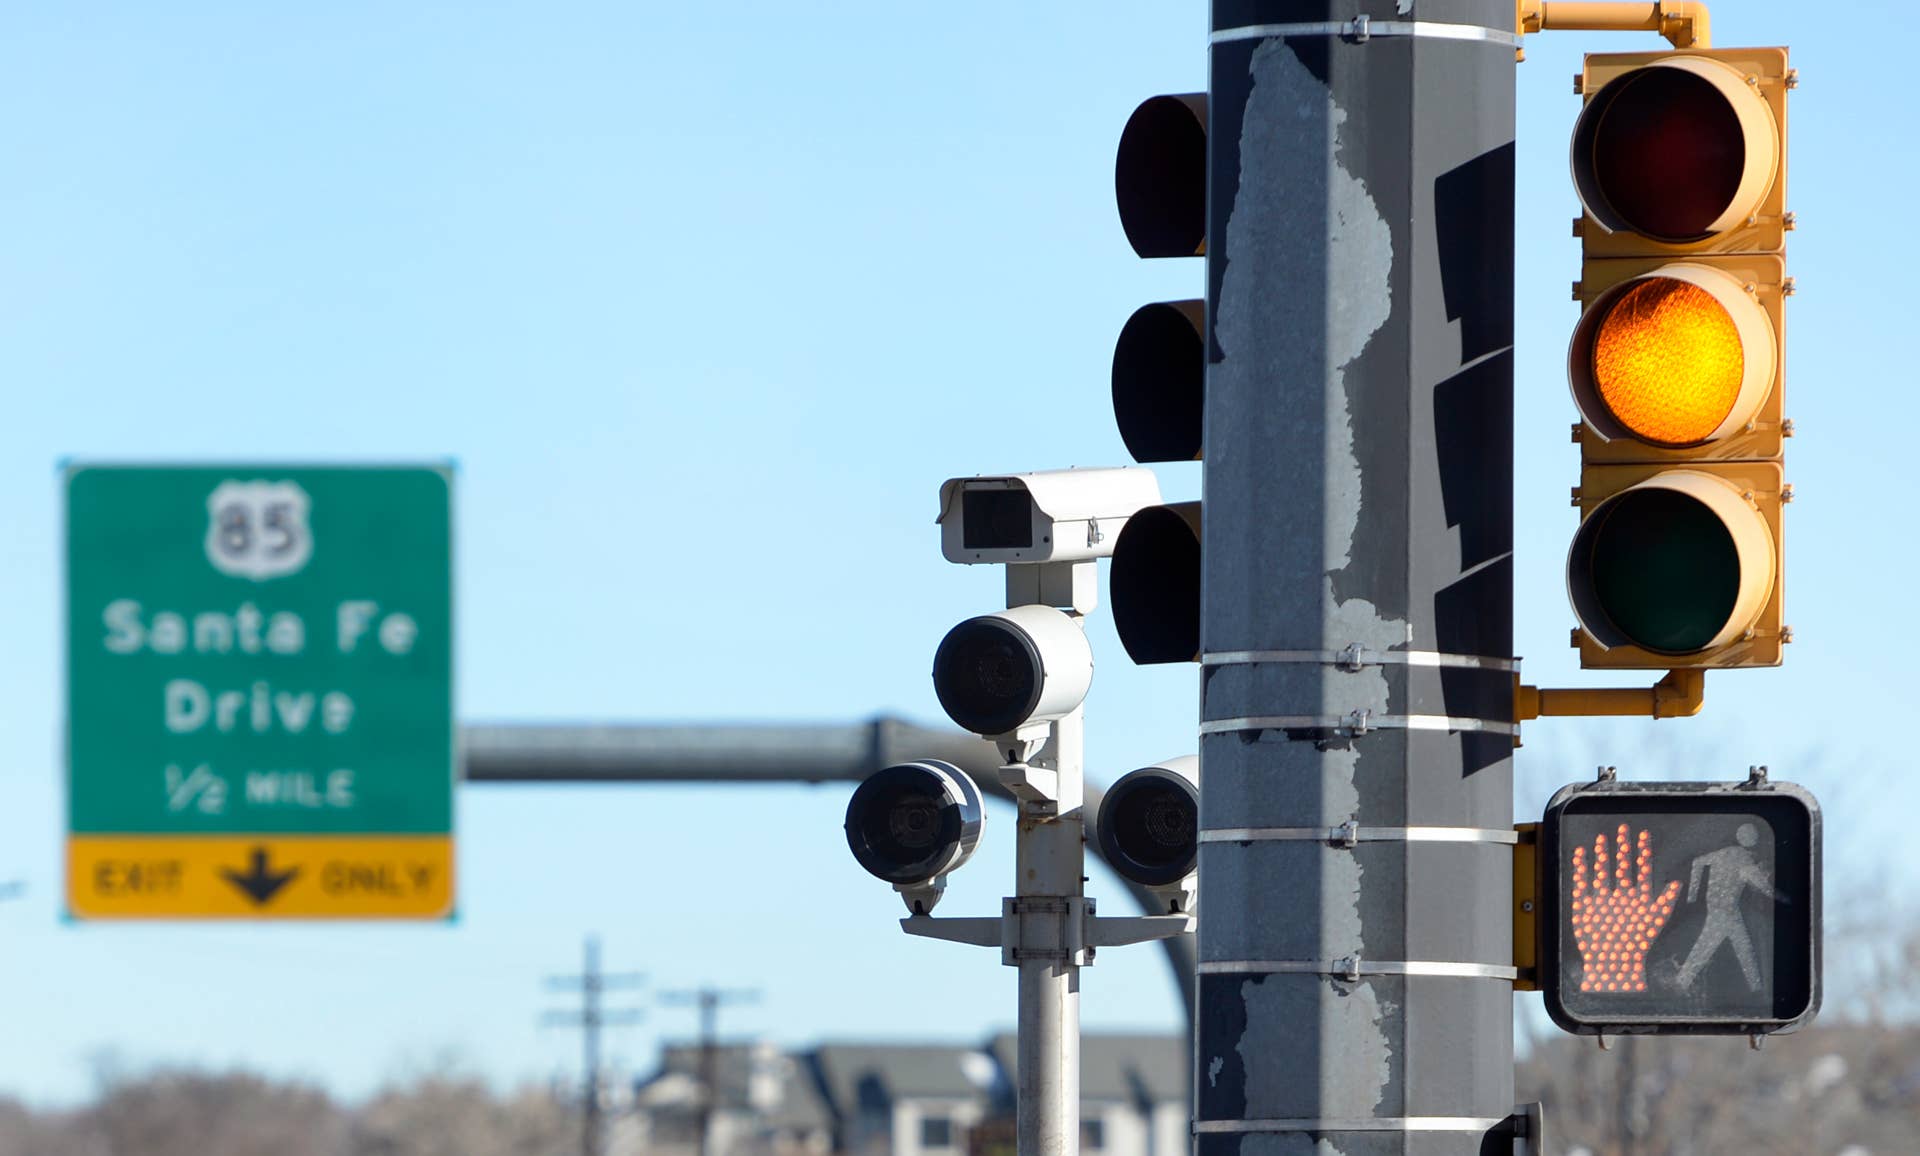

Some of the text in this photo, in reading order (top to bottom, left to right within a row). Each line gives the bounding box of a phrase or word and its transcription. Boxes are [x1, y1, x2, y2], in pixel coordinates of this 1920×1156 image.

[215, 502, 299, 558] 85
[103, 599, 417, 653] Santa Fe
[165, 680, 354, 733] Drive
[245, 769, 354, 807] MILE
[95, 860, 435, 896] EXIT ONLY
